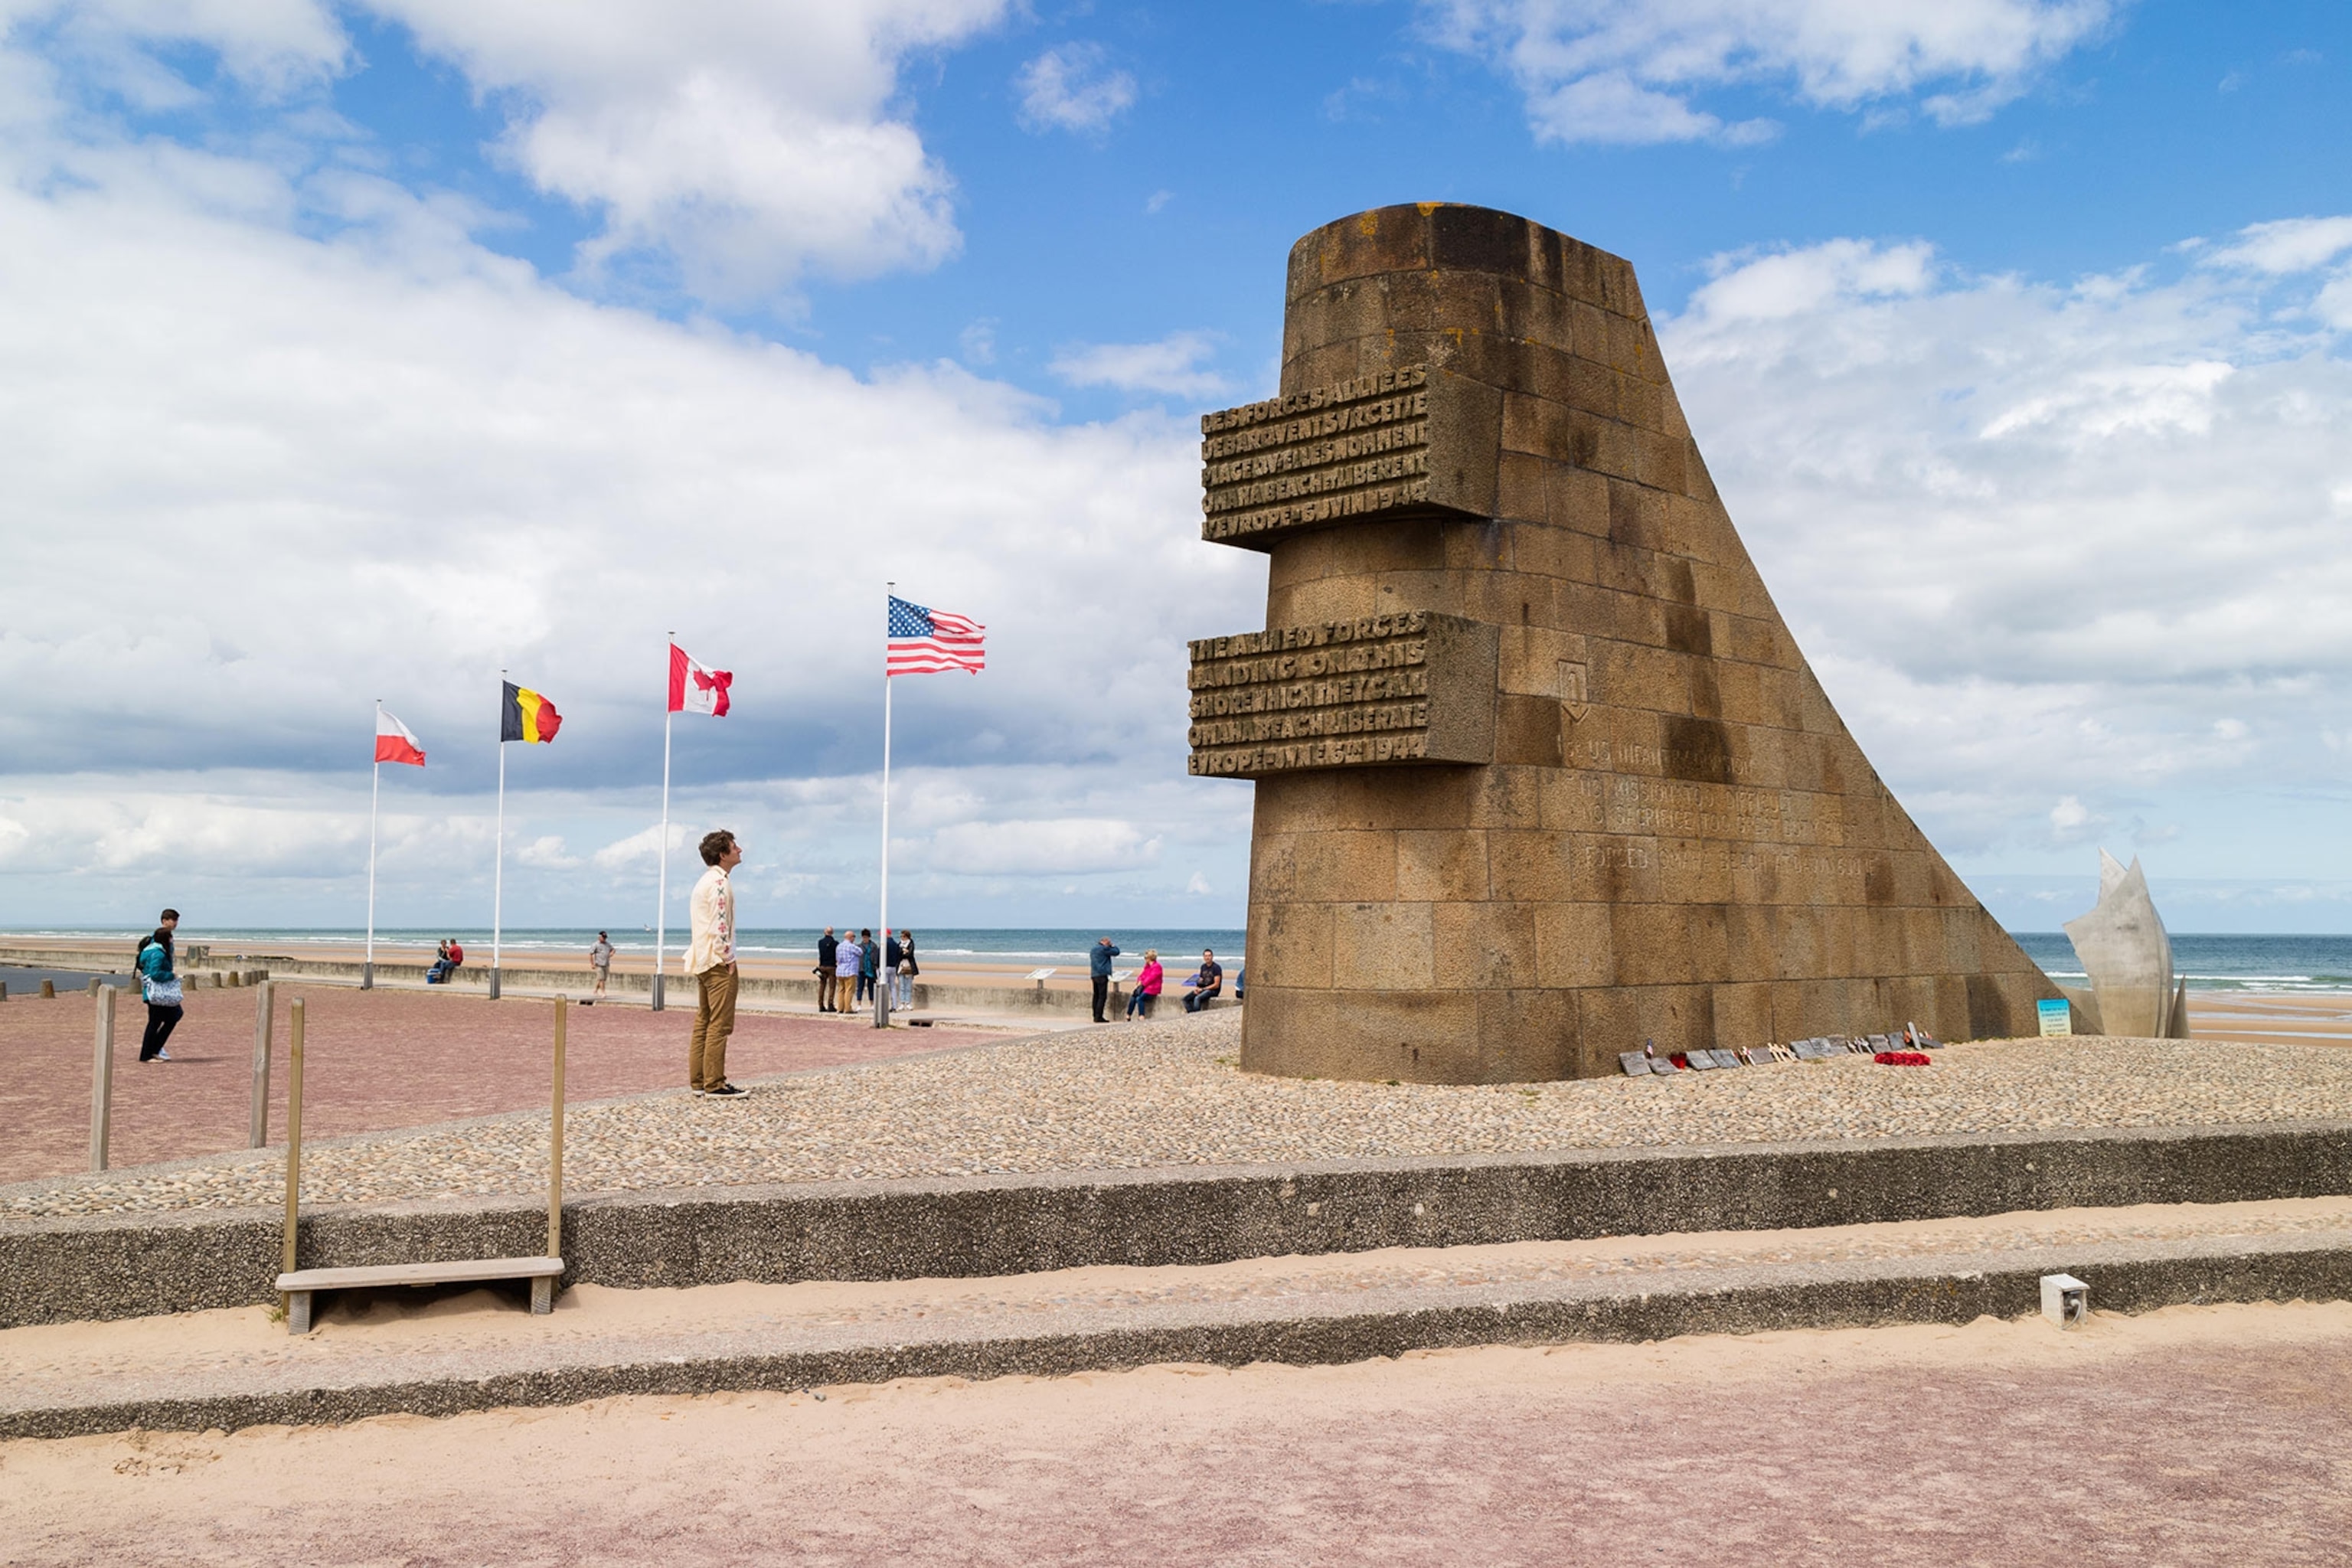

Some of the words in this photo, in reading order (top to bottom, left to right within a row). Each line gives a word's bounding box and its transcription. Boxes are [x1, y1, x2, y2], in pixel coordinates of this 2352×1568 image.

[1201, 408, 1238, 434] LES
[1241, 387, 1324, 426] FORCES
[1331, 364, 1426, 404] ALLIEES
[1367, 393, 1427, 424] CETTE
[1334, 423, 1427, 459] NOMMENT
[1201, 483, 1263, 514] OMAHA
[1264, 472, 1321, 503] BEACH
[1339, 452, 1427, 486] LIBERENT
[1302, 502, 1315, 523] 6
[1364, 482, 1427, 511] 1944
[1187, 637, 1227, 662] THE
[1229, 626, 1314, 658] ALLIED
[1322, 611, 1425, 645] FORCES
[1187, 657, 1296, 691] LANDING
[1306, 651, 1345, 678] ON
[1347, 642, 1425, 671] THIS
[1188, 691, 1252, 718] SHORE
[1253, 683, 1313, 712] WHICH
[1314, 678, 1368, 707] THEY
[1368, 672, 1426, 700] CALL
[1188, 720, 1256, 747] OMAHA
[1258, 713, 1323, 741] BEACH
[1324, 704, 1426, 736] LIBERATE
[1365, 735, 1426, 761] 1944
